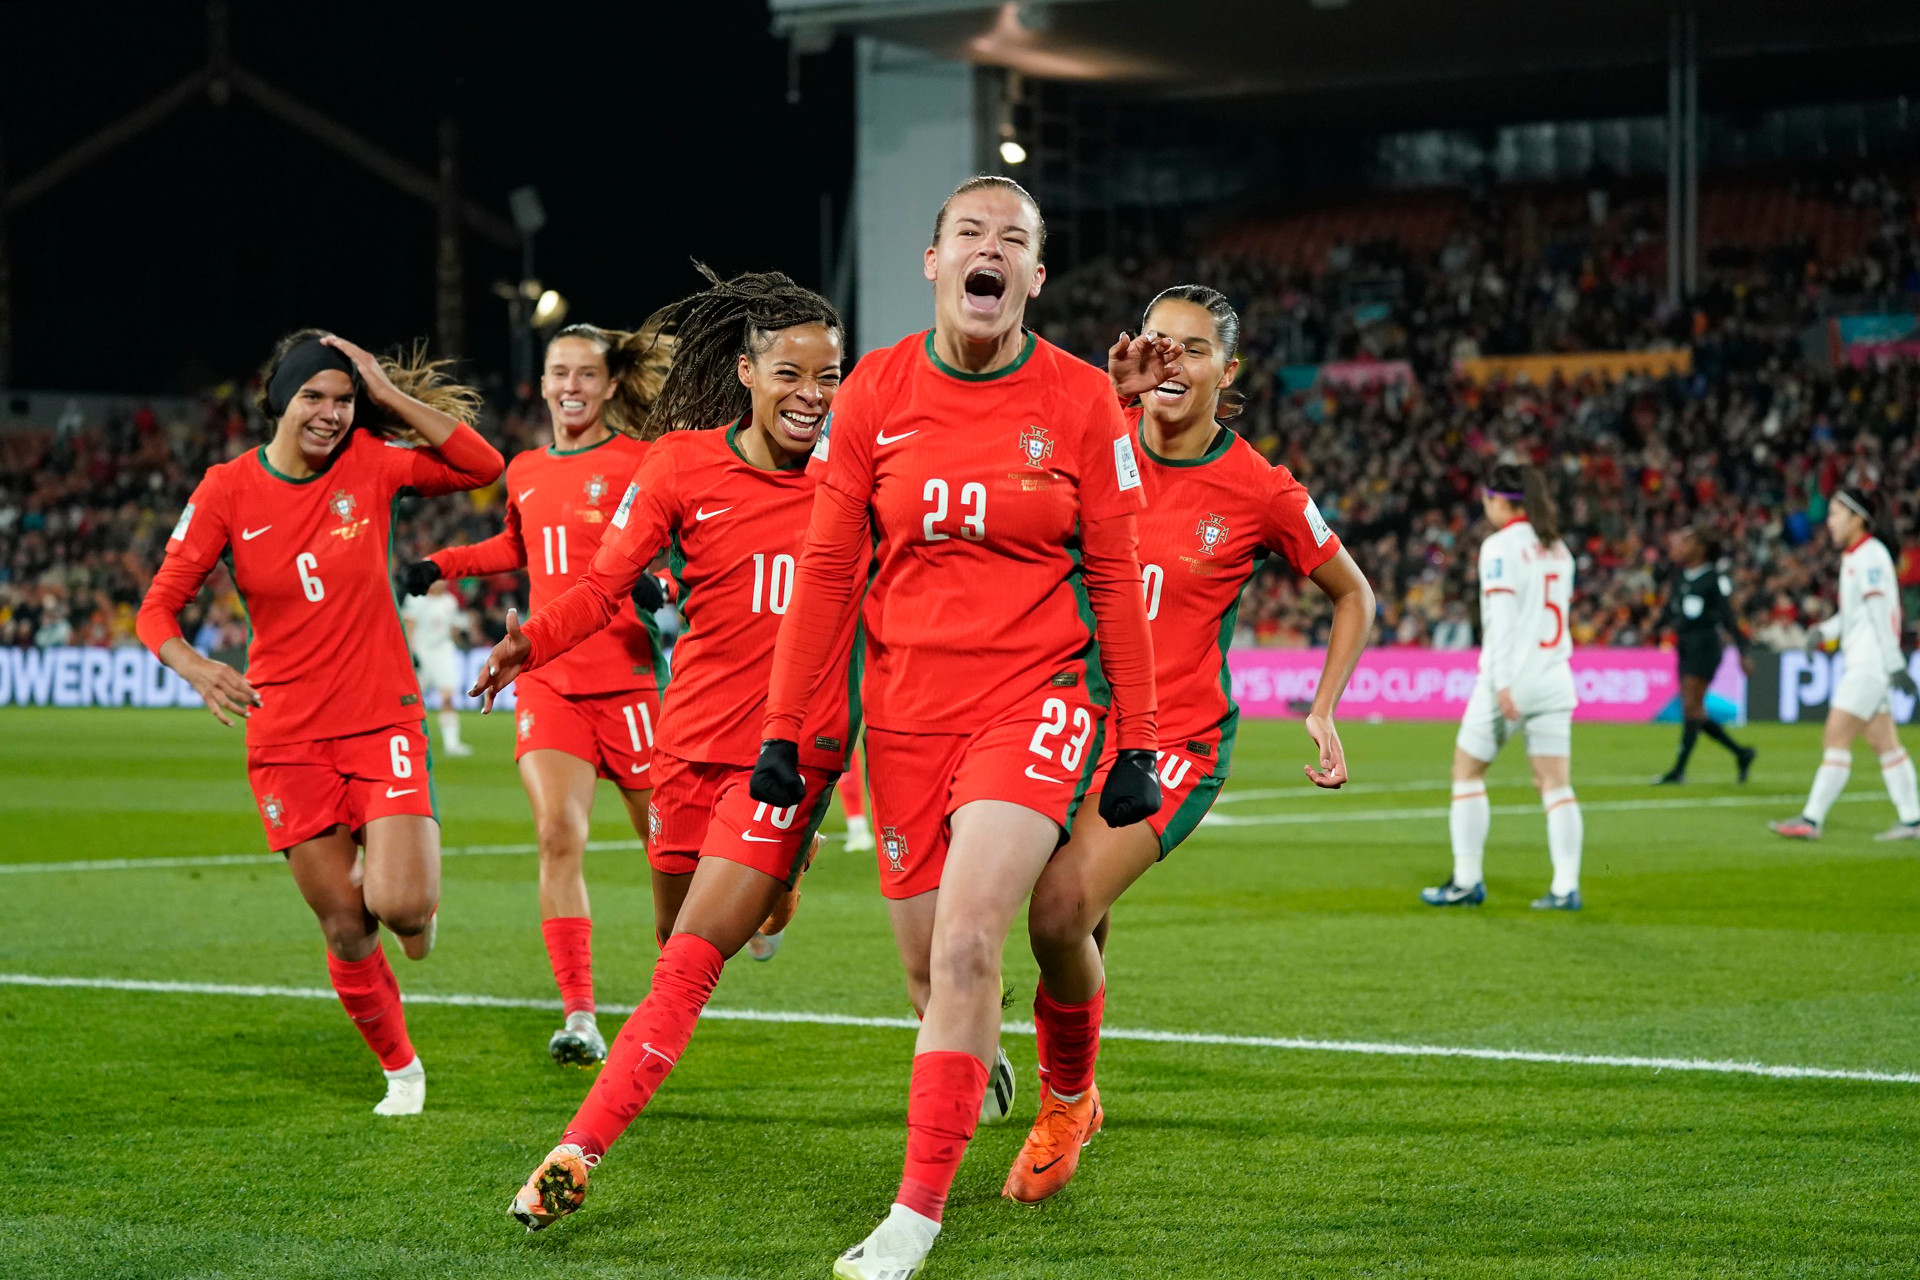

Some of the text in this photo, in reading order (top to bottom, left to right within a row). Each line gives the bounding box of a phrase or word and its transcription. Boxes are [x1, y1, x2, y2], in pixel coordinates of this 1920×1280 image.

[922, 478, 987, 541] 23
[542, 525, 568, 575] 11
[296, 552, 325, 602] 6
[752, 553, 795, 615] 10
[1142, 563, 1164, 621] 0
[1539, 573, 1562, 648] 5
[1276, 667, 1380, 702] WOLD
[1381, 667, 1445, 702] CUP
[622, 702, 654, 752] 11
[1028, 697, 1091, 772] 23
[389, 735, 412, 778] 6
[1148, 750, 1192, 790] 0
